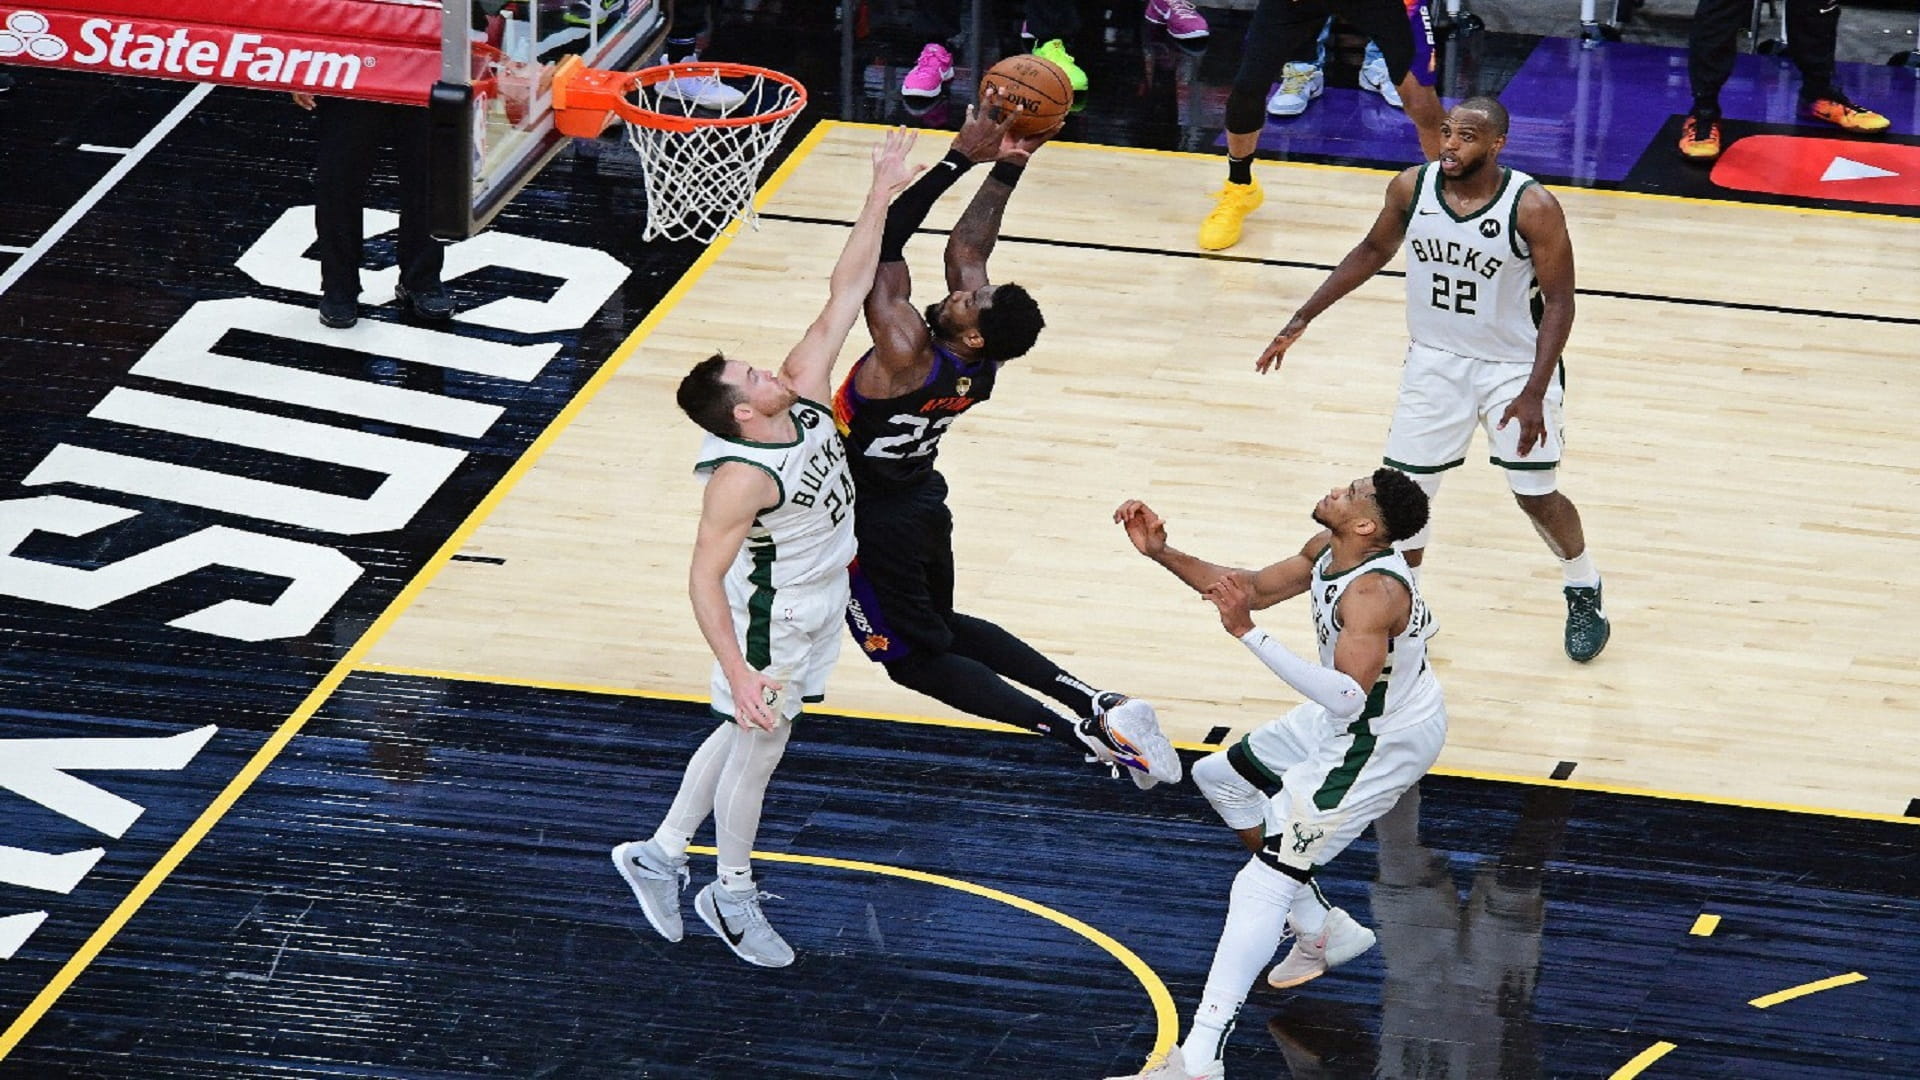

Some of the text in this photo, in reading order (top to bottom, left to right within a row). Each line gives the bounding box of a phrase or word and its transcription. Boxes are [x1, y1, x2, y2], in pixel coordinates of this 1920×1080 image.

[1411, 238, 1503, 280] BUCKS
[1431, 272, 1478, 315] 22
[824, 472, 855, 528] 24
